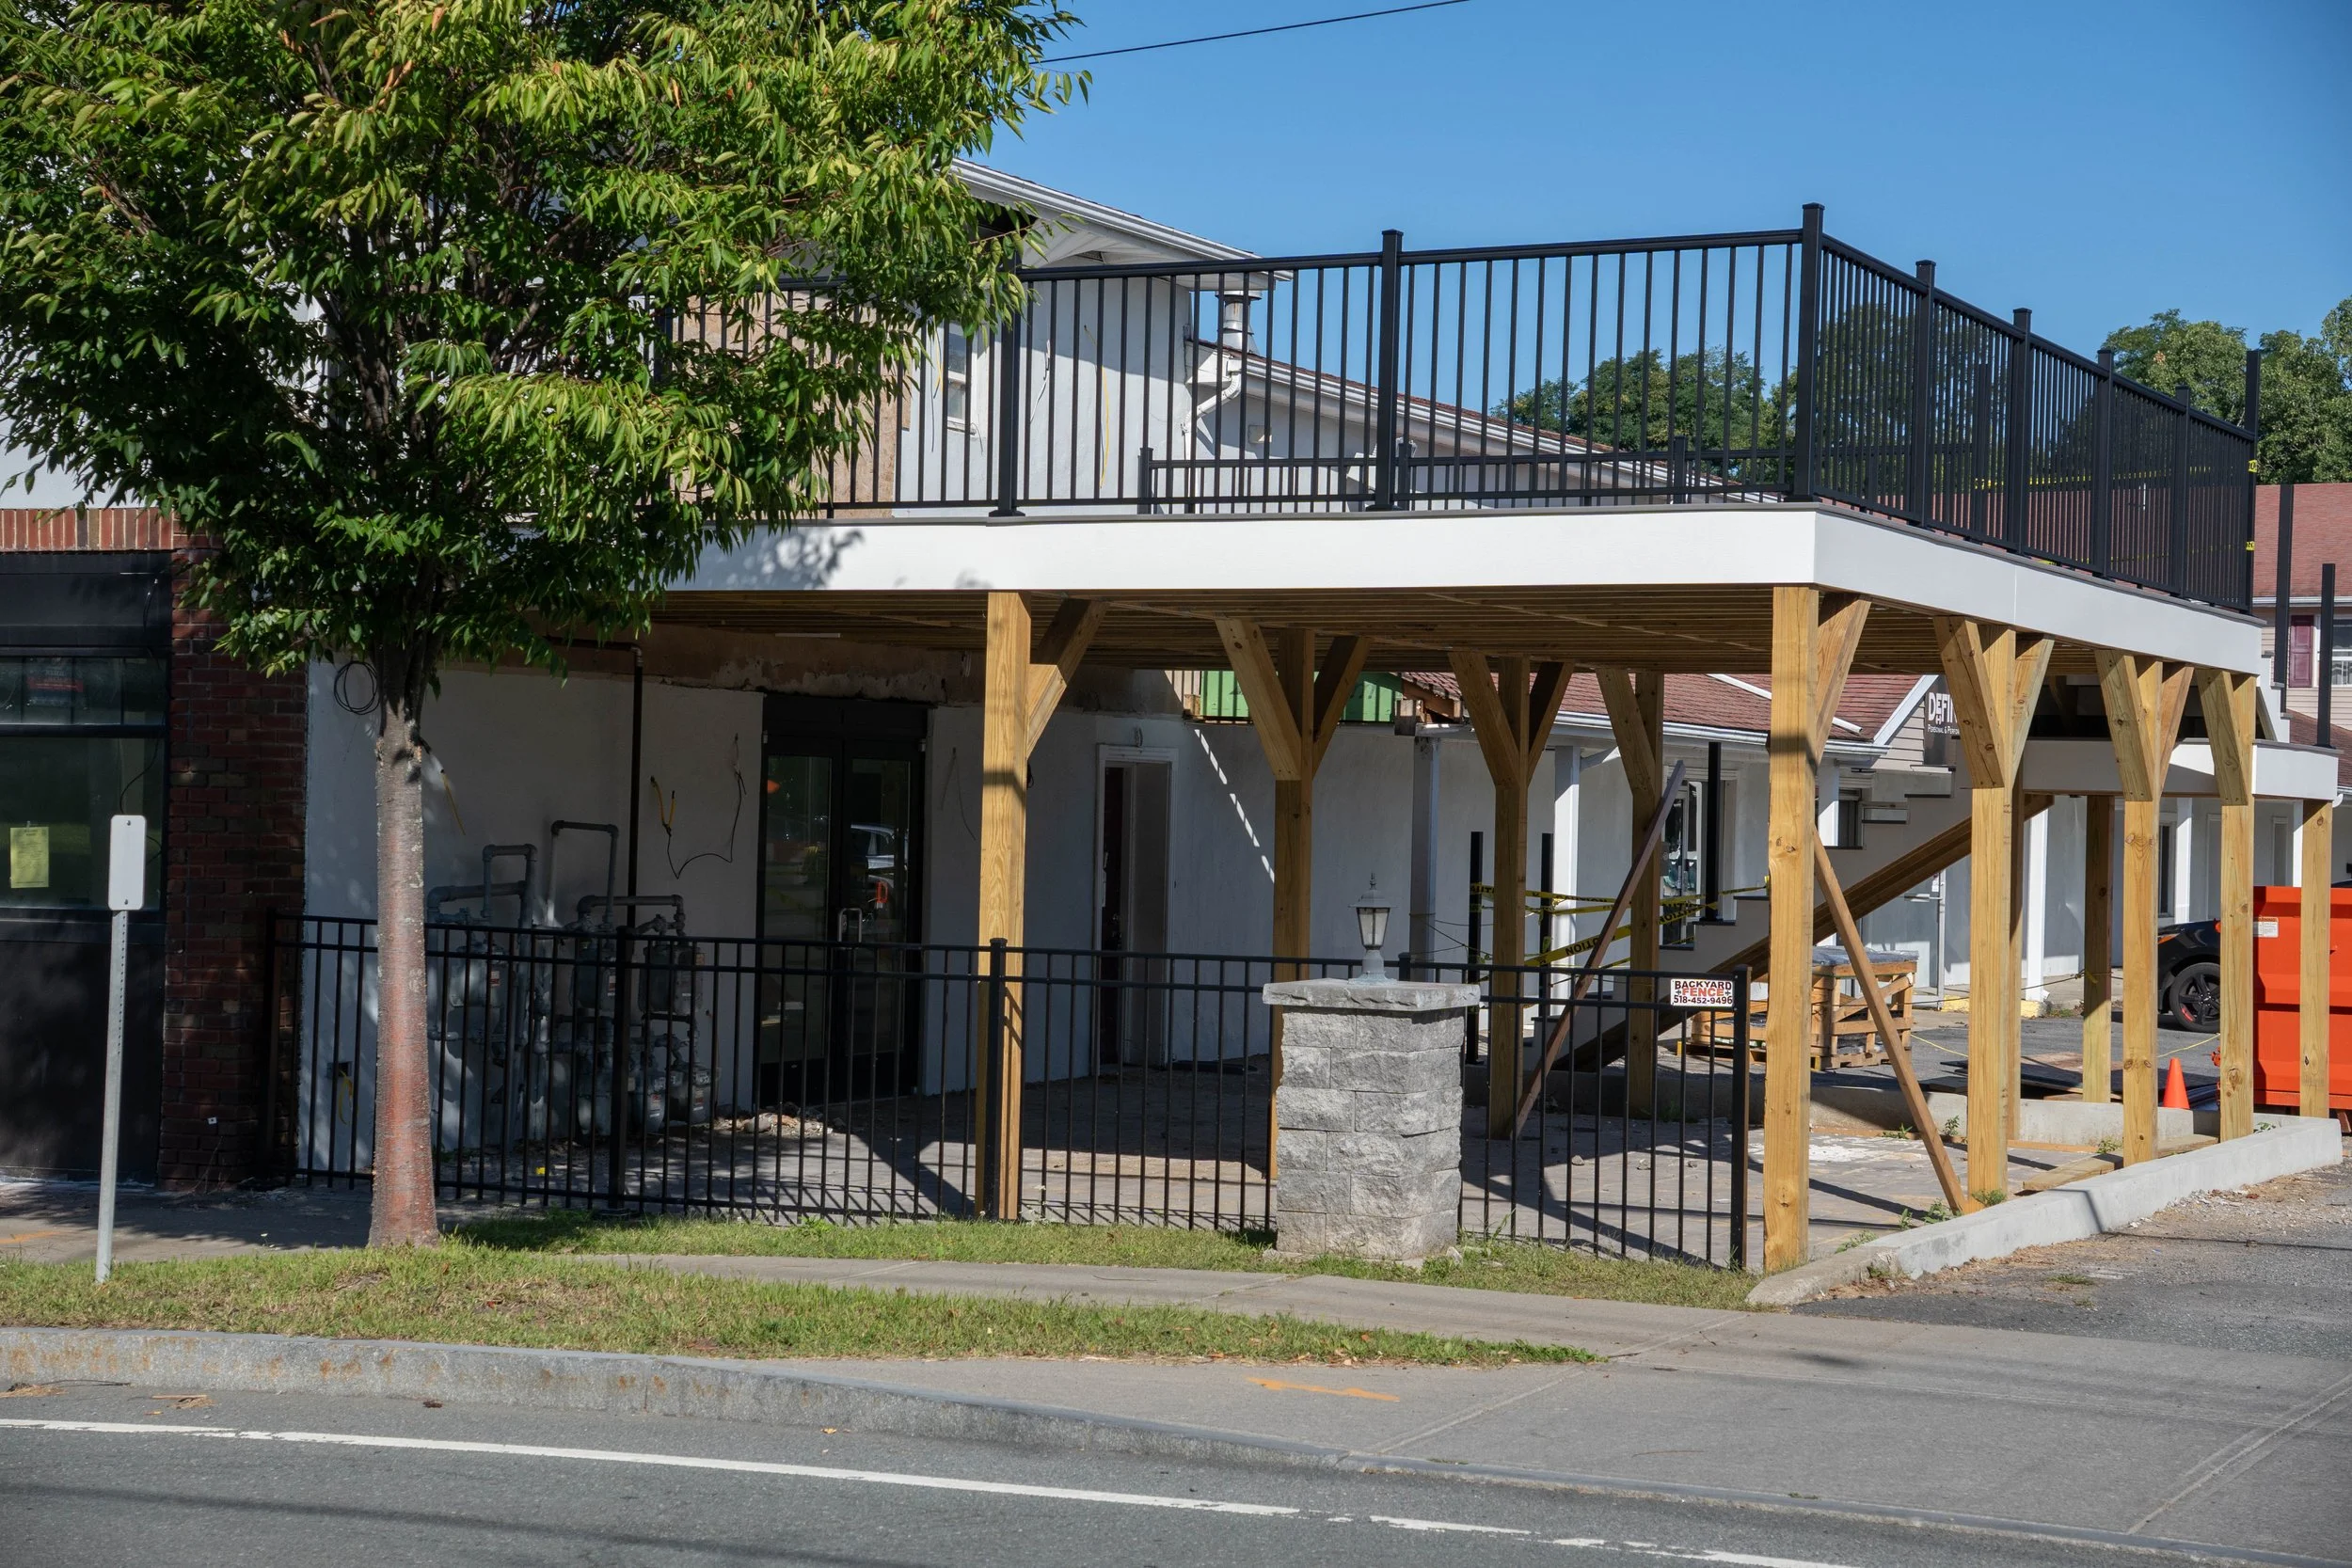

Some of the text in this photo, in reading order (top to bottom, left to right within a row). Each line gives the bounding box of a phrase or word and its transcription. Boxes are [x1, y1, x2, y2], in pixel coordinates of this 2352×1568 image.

[1675, 980, 1732, 990] BACKYARD
[1682, 988, 1724, 997] FENCE
[1674, 994, 1733, 1005] 518-452-9496
